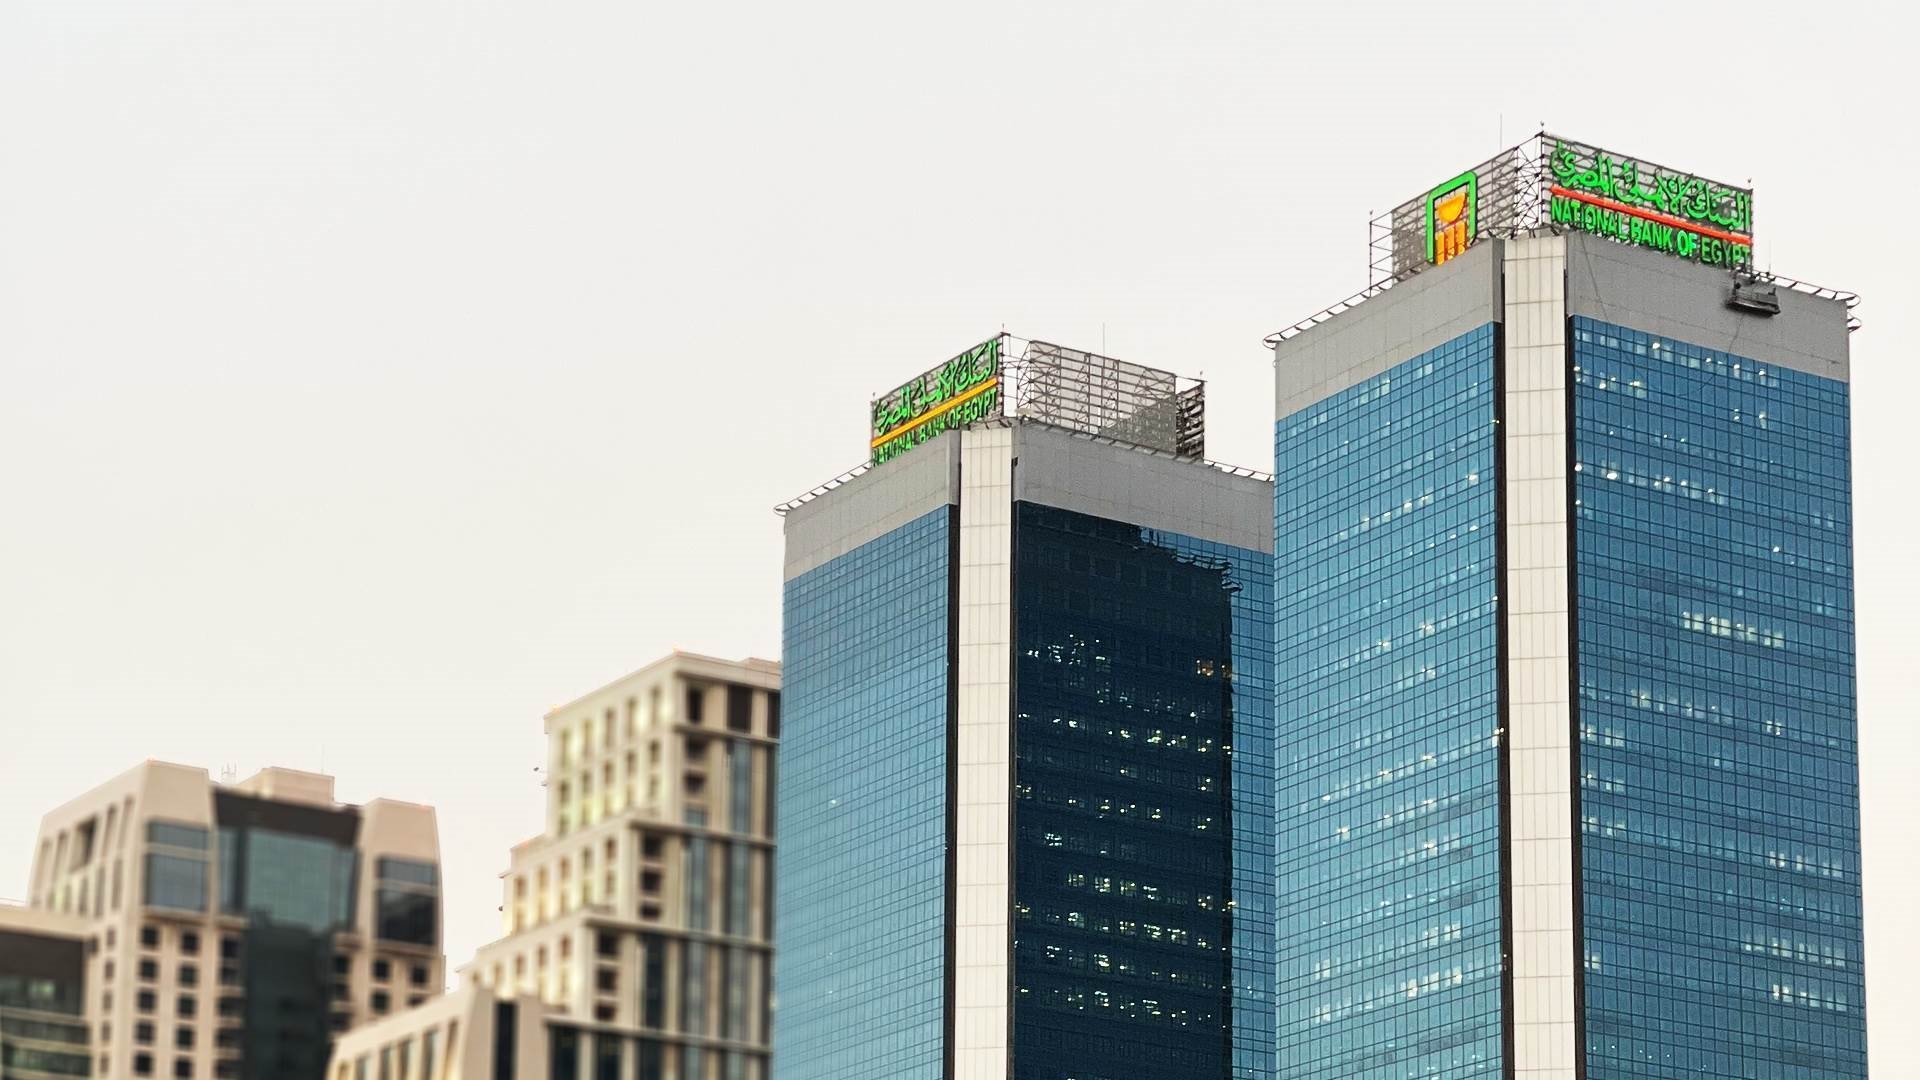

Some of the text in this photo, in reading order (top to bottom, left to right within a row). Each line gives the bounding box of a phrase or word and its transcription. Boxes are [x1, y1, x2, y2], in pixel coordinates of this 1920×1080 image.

[1551, 196, 1750, 266] NATIONAL BANK OF EGYPT
[872, 388, 997, 466] NATIONAL BANK OF EGYPT
